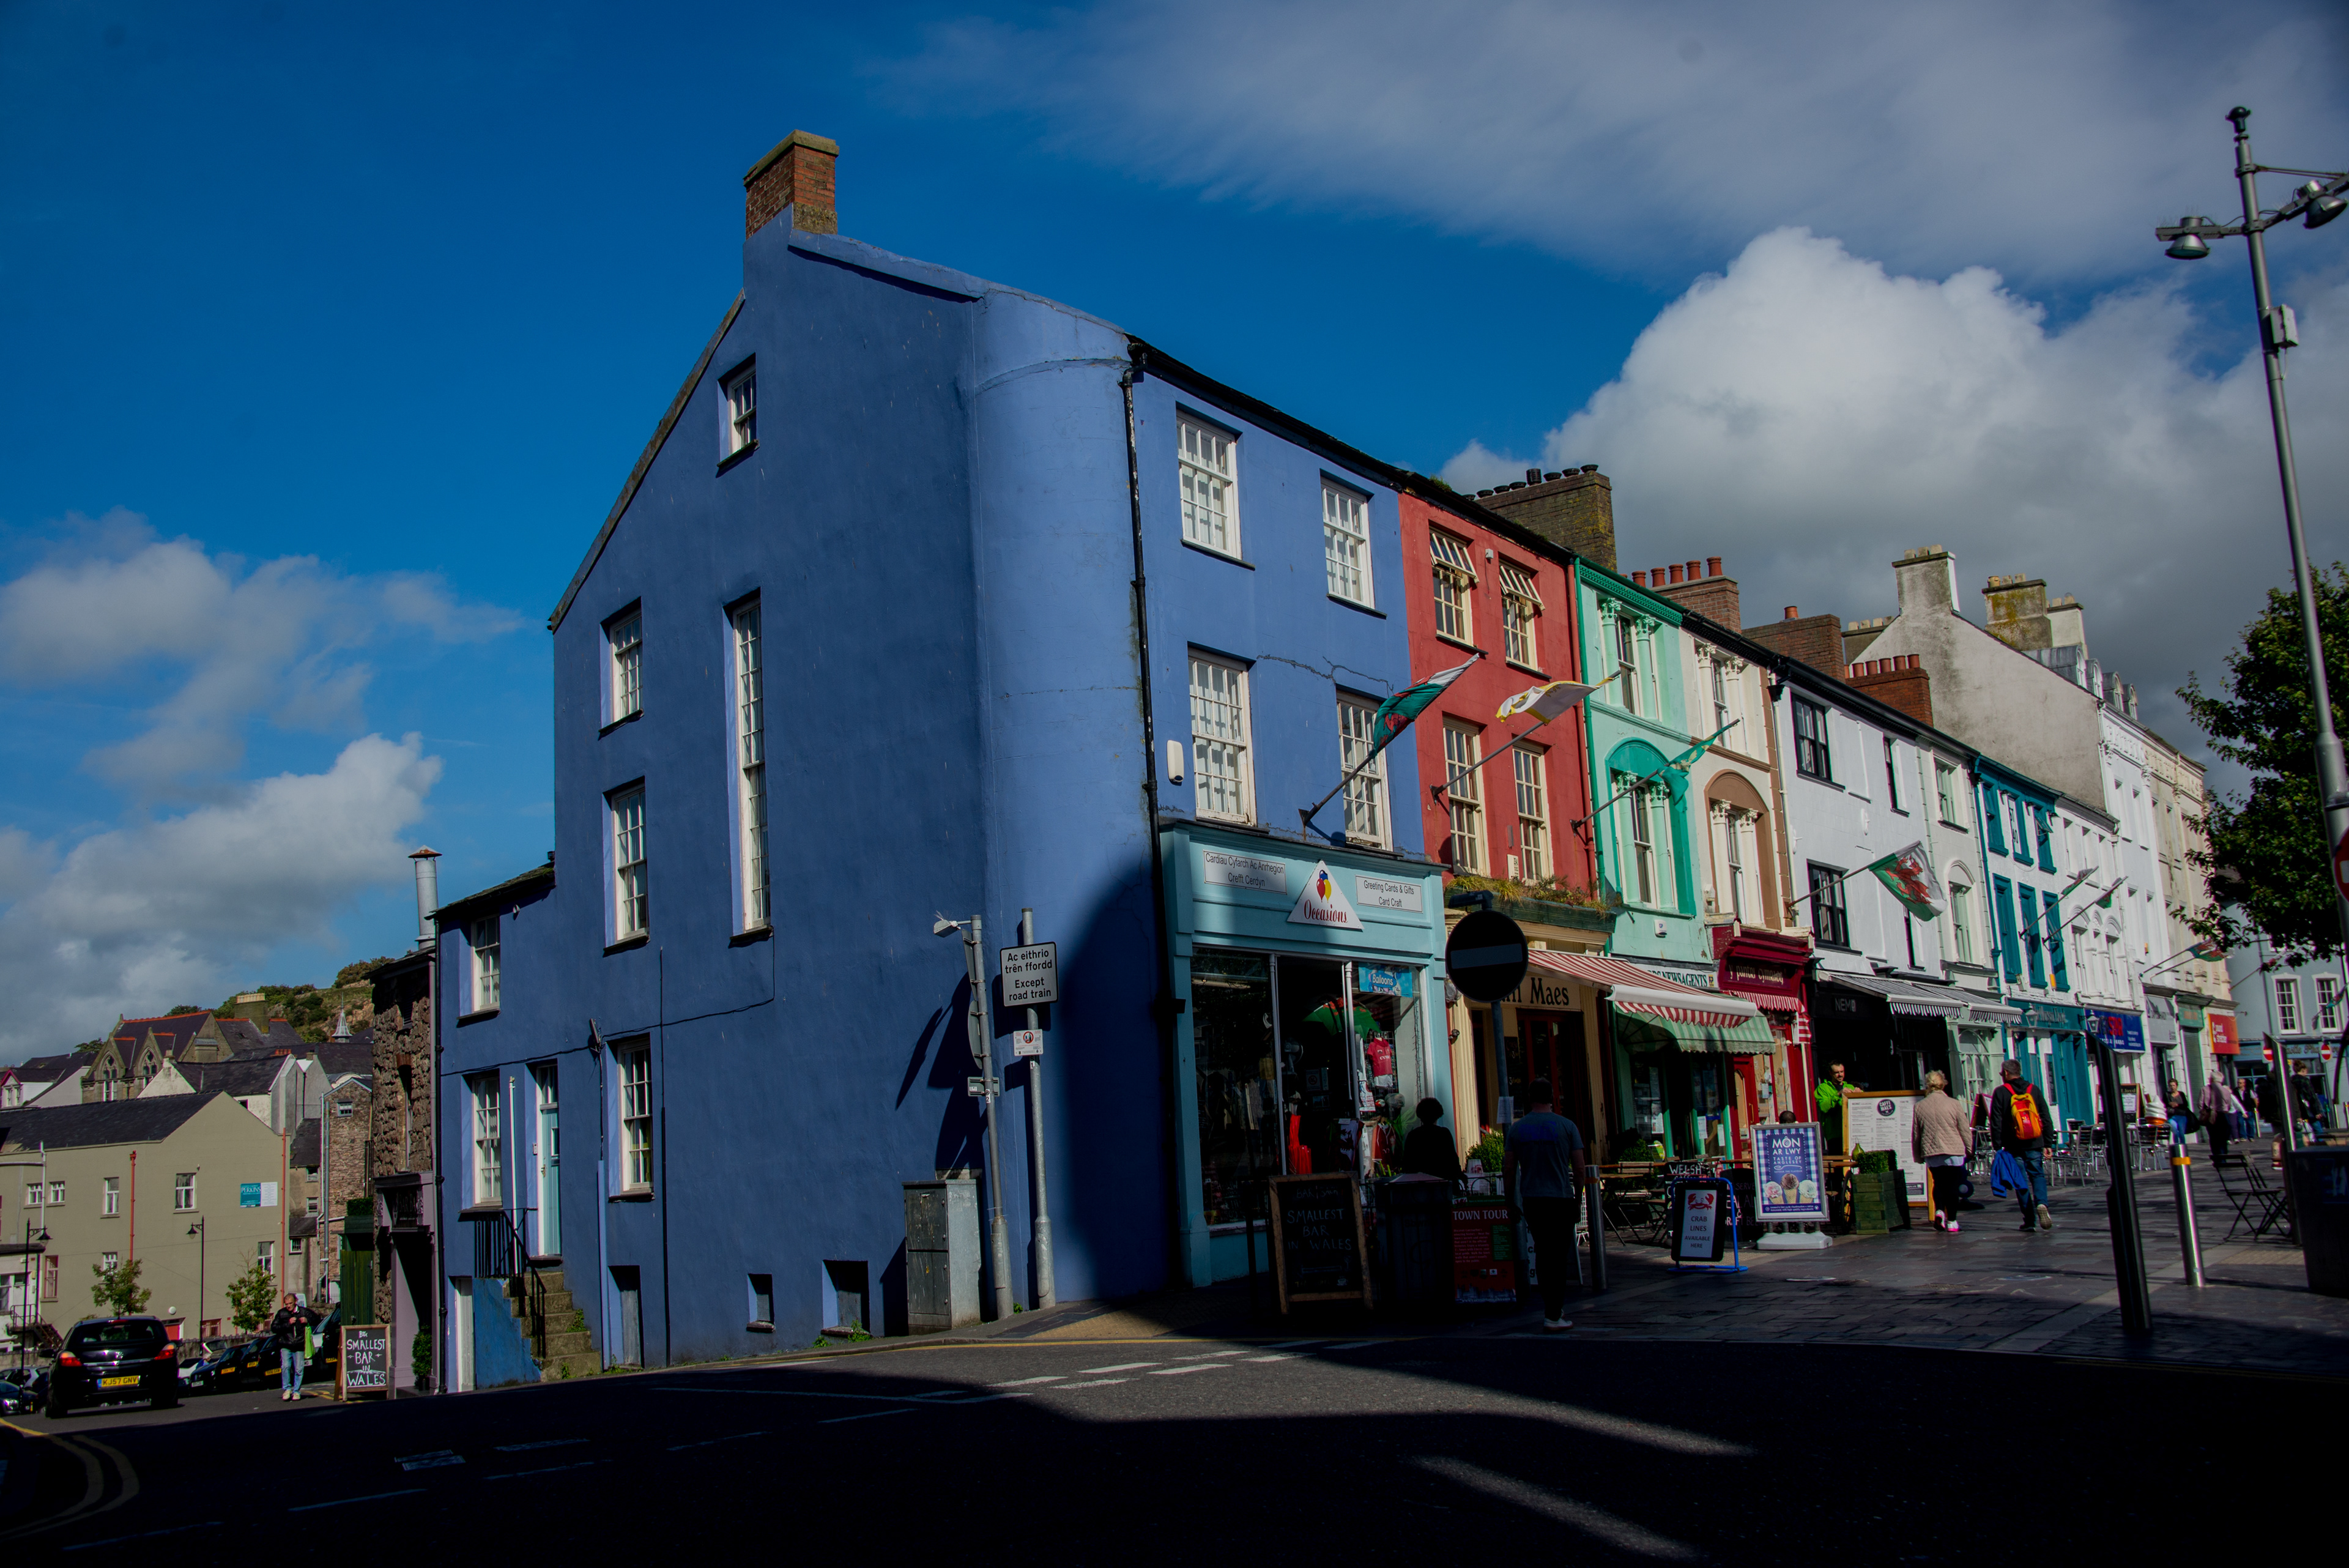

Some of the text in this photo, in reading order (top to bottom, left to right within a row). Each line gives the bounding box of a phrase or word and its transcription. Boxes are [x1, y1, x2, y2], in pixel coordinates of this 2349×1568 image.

[1205, 852, 1284, 875] Cardiau Cyfarch Ac Anrhegion
[1228, 872, 1265, 888] Crefft Cerdyn
[1364, 880, 1384, 893] Greeting
[1385, 883, 1398, 893] Cards
[1404, 886, 1414, 895] Gifts
[1379, 896, 1402, 908] Card Craft
[1304, 899, 1348, 924] Occasions
[1008, 949, 1049, 962] Ac eithrio
[1005, 960, 1052, 974] trên ffordd
[1015, 977, 1044, 989] Except
[1372, 973, 1393, 986] Balloons
[1662, 972, 1707, 987] NEWSAGENTS
[1009, 988, 1051, 1001] road train
[1530, 977, 1569, 1006] Maes
[1835, 998, 1857, 1013] NEMO
[1772, 1136, 1800, 1148] MÔN
[1669, 1164, 1702, 1175] WELSH
[1286, 1209, 1345, 1224] SMALLEST
[1453, 1209, 1508, 1221] TOWN TOUR
[1302, 1225, 1329, 1238] BAR
[1287, 1238, 1352, 1250] IN WALES
[346, 1339, 386, 1350] SMALLEST
[355, 1351, 376, 1364] BAR
[347, 1372, 386, 1386] WALES
